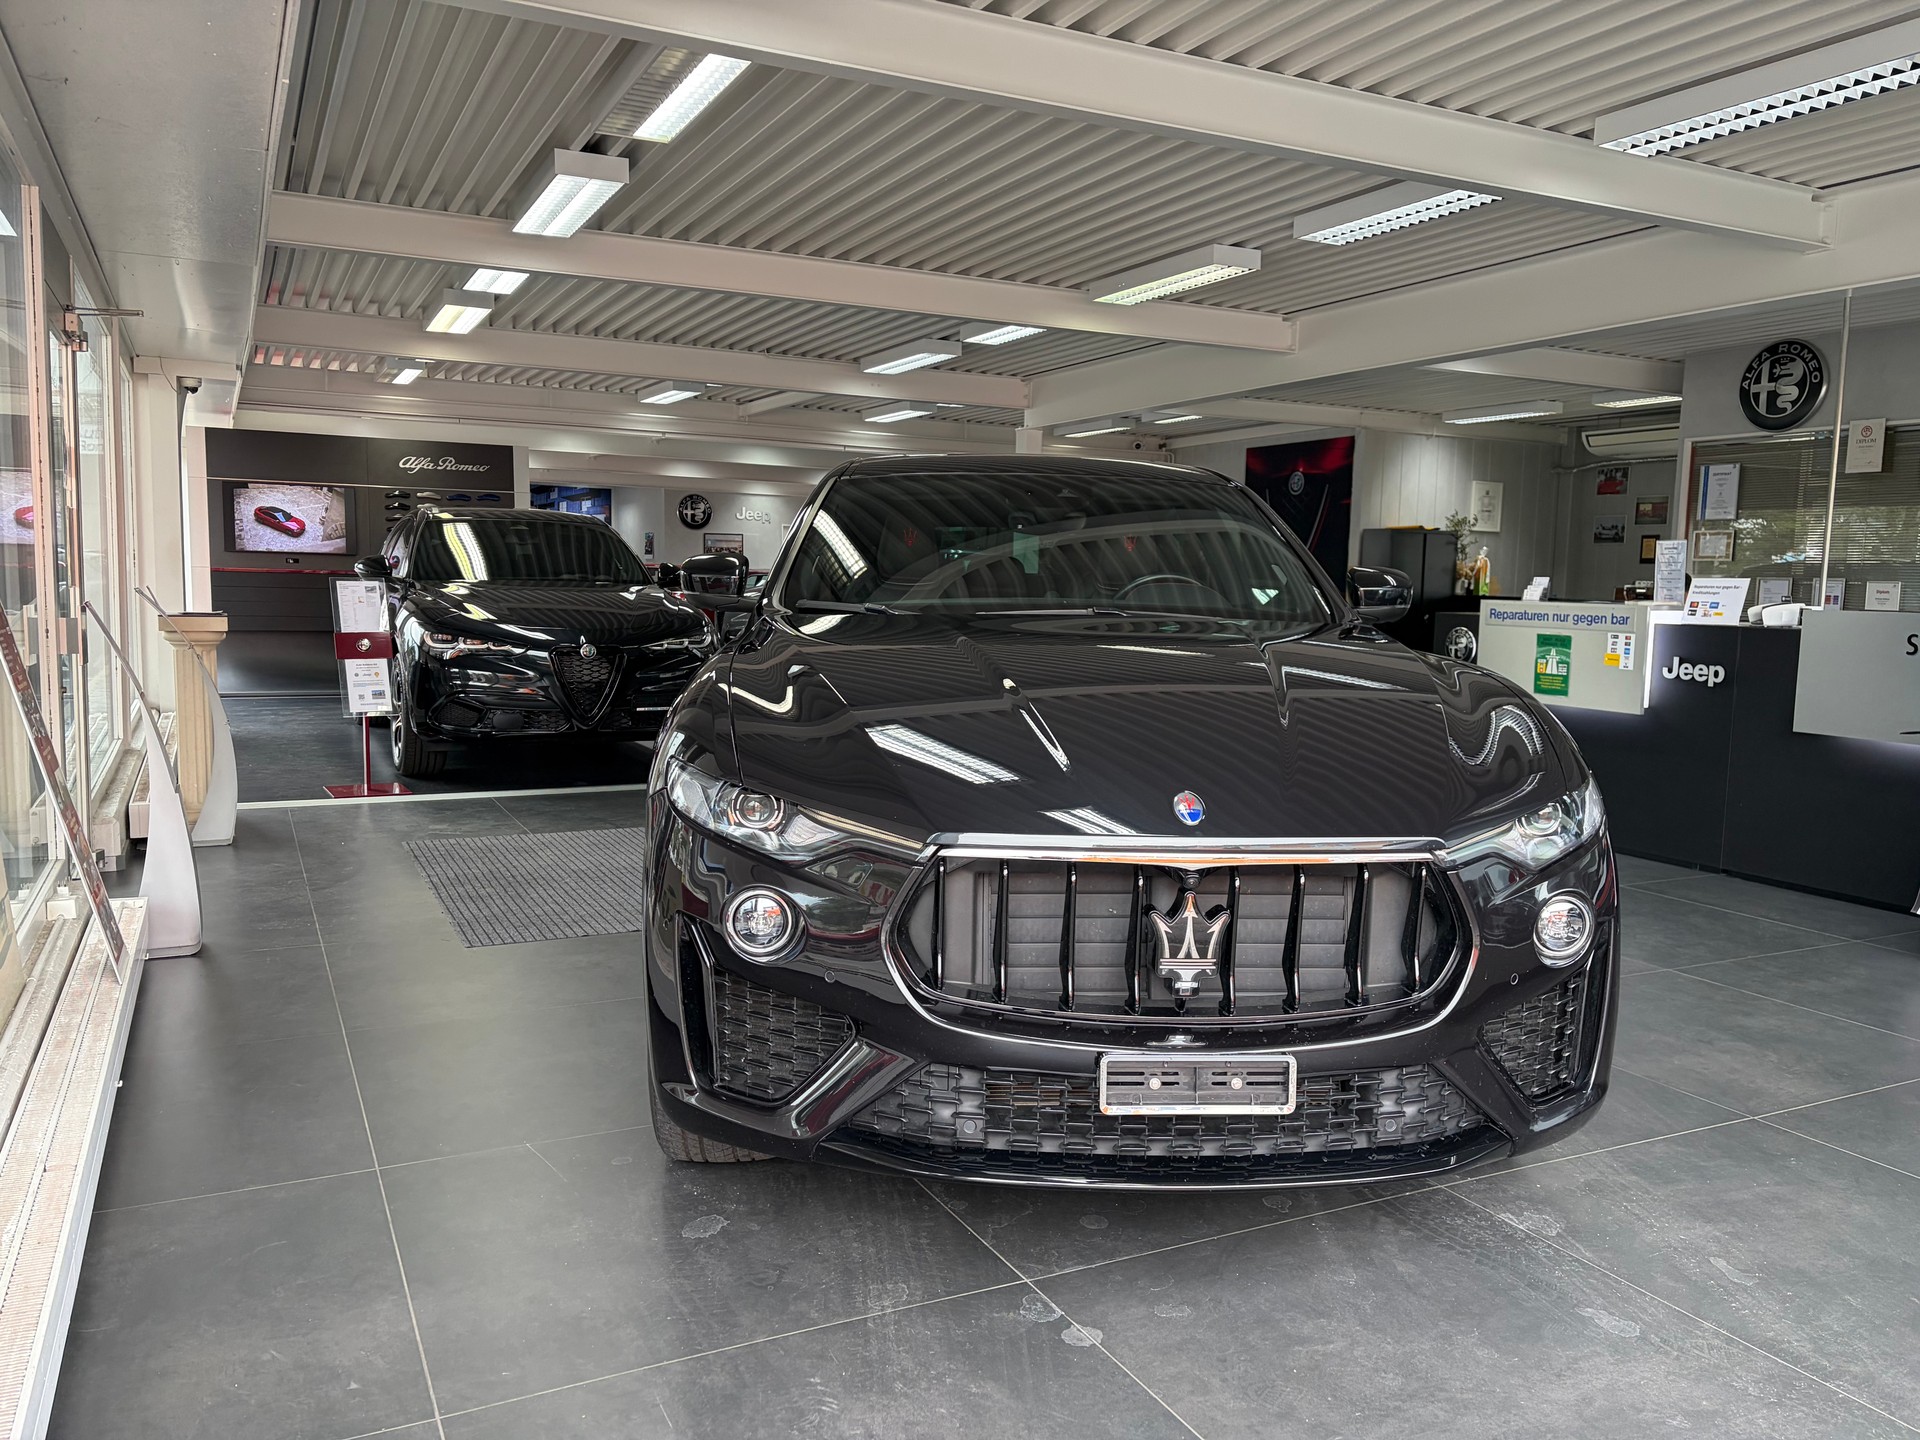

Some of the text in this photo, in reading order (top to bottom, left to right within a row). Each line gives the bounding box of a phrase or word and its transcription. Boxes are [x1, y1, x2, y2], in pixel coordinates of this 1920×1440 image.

[1742, 344, 1821, 390] ALFA ROMEO
[399, 456, 491, 474] Alfa Romeo
[736, 506, 771, 524] Jeep
[1489, 608, 1631, 626] Reparaturen nur gegen bar
[1662, 656, 1726, 687] Jeep
